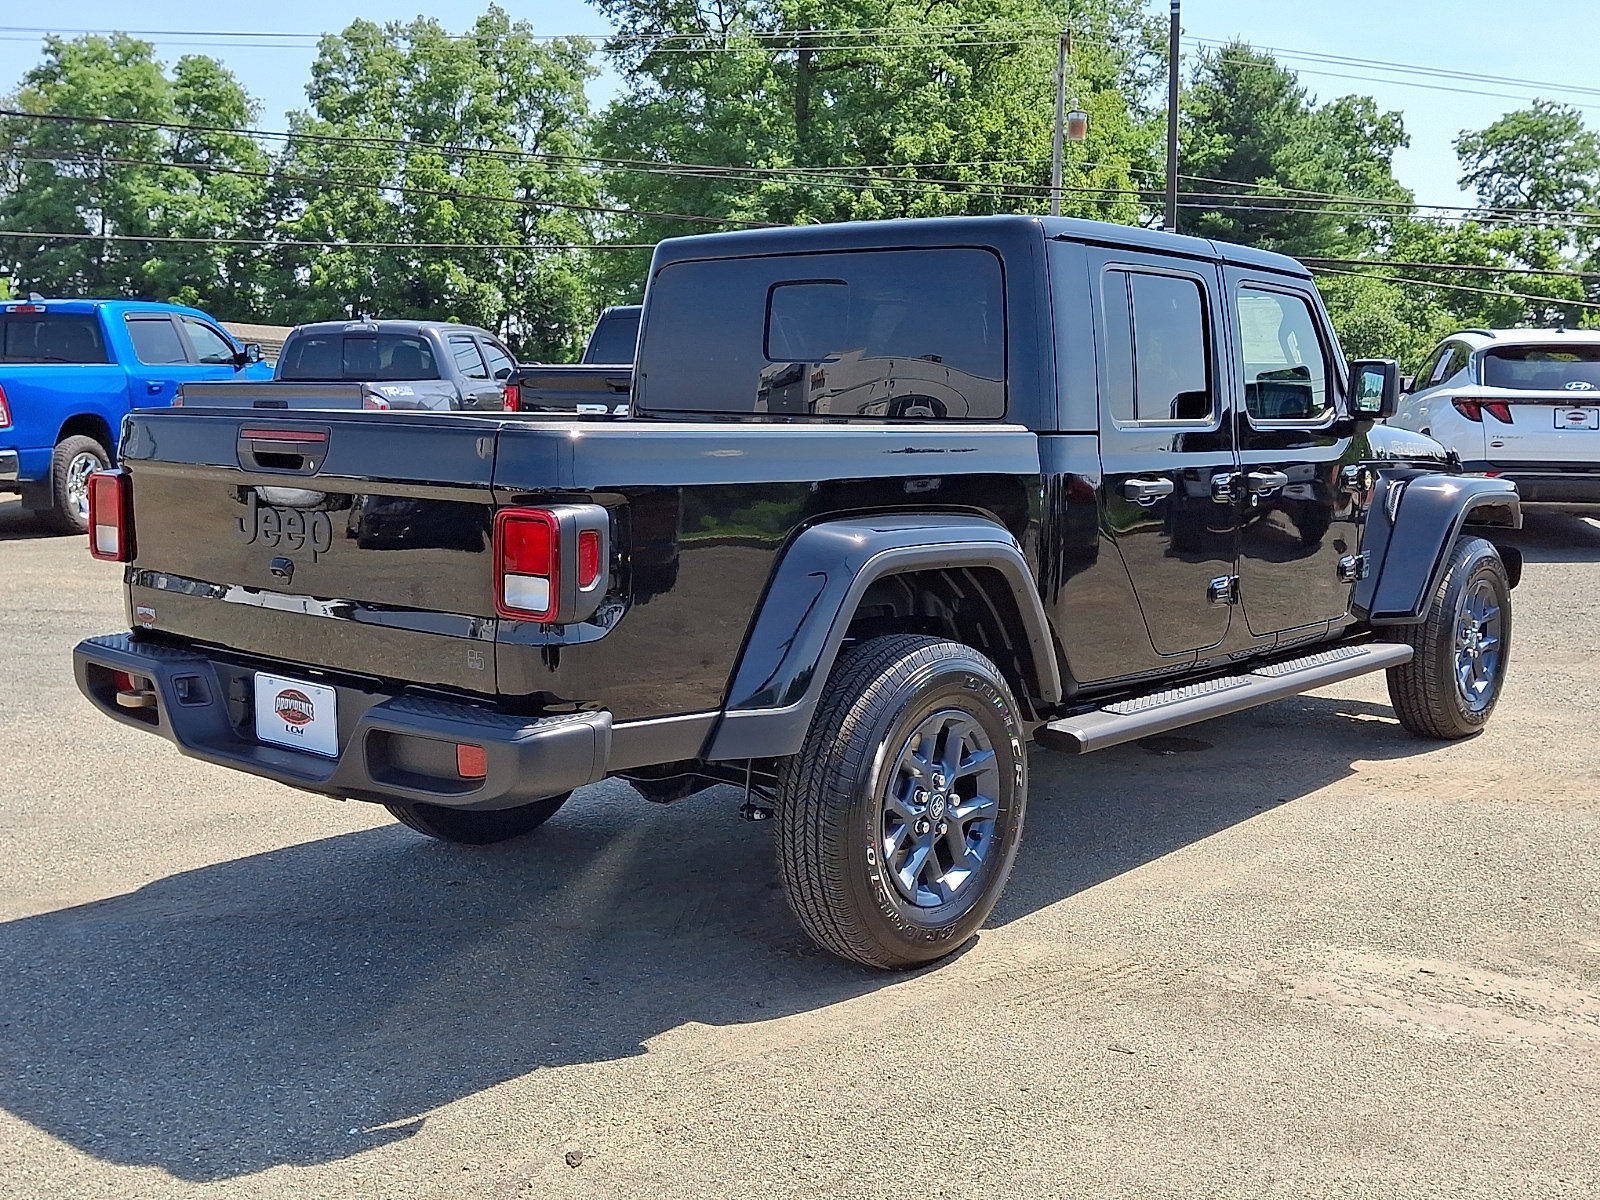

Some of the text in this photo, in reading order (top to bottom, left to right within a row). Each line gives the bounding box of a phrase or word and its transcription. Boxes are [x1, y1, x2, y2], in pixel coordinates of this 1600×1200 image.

[235, 490, 332, 564] Jeep
[275, 696, 315, 721] PROVIDENCE
[285, 724, 304, 735] LCM
